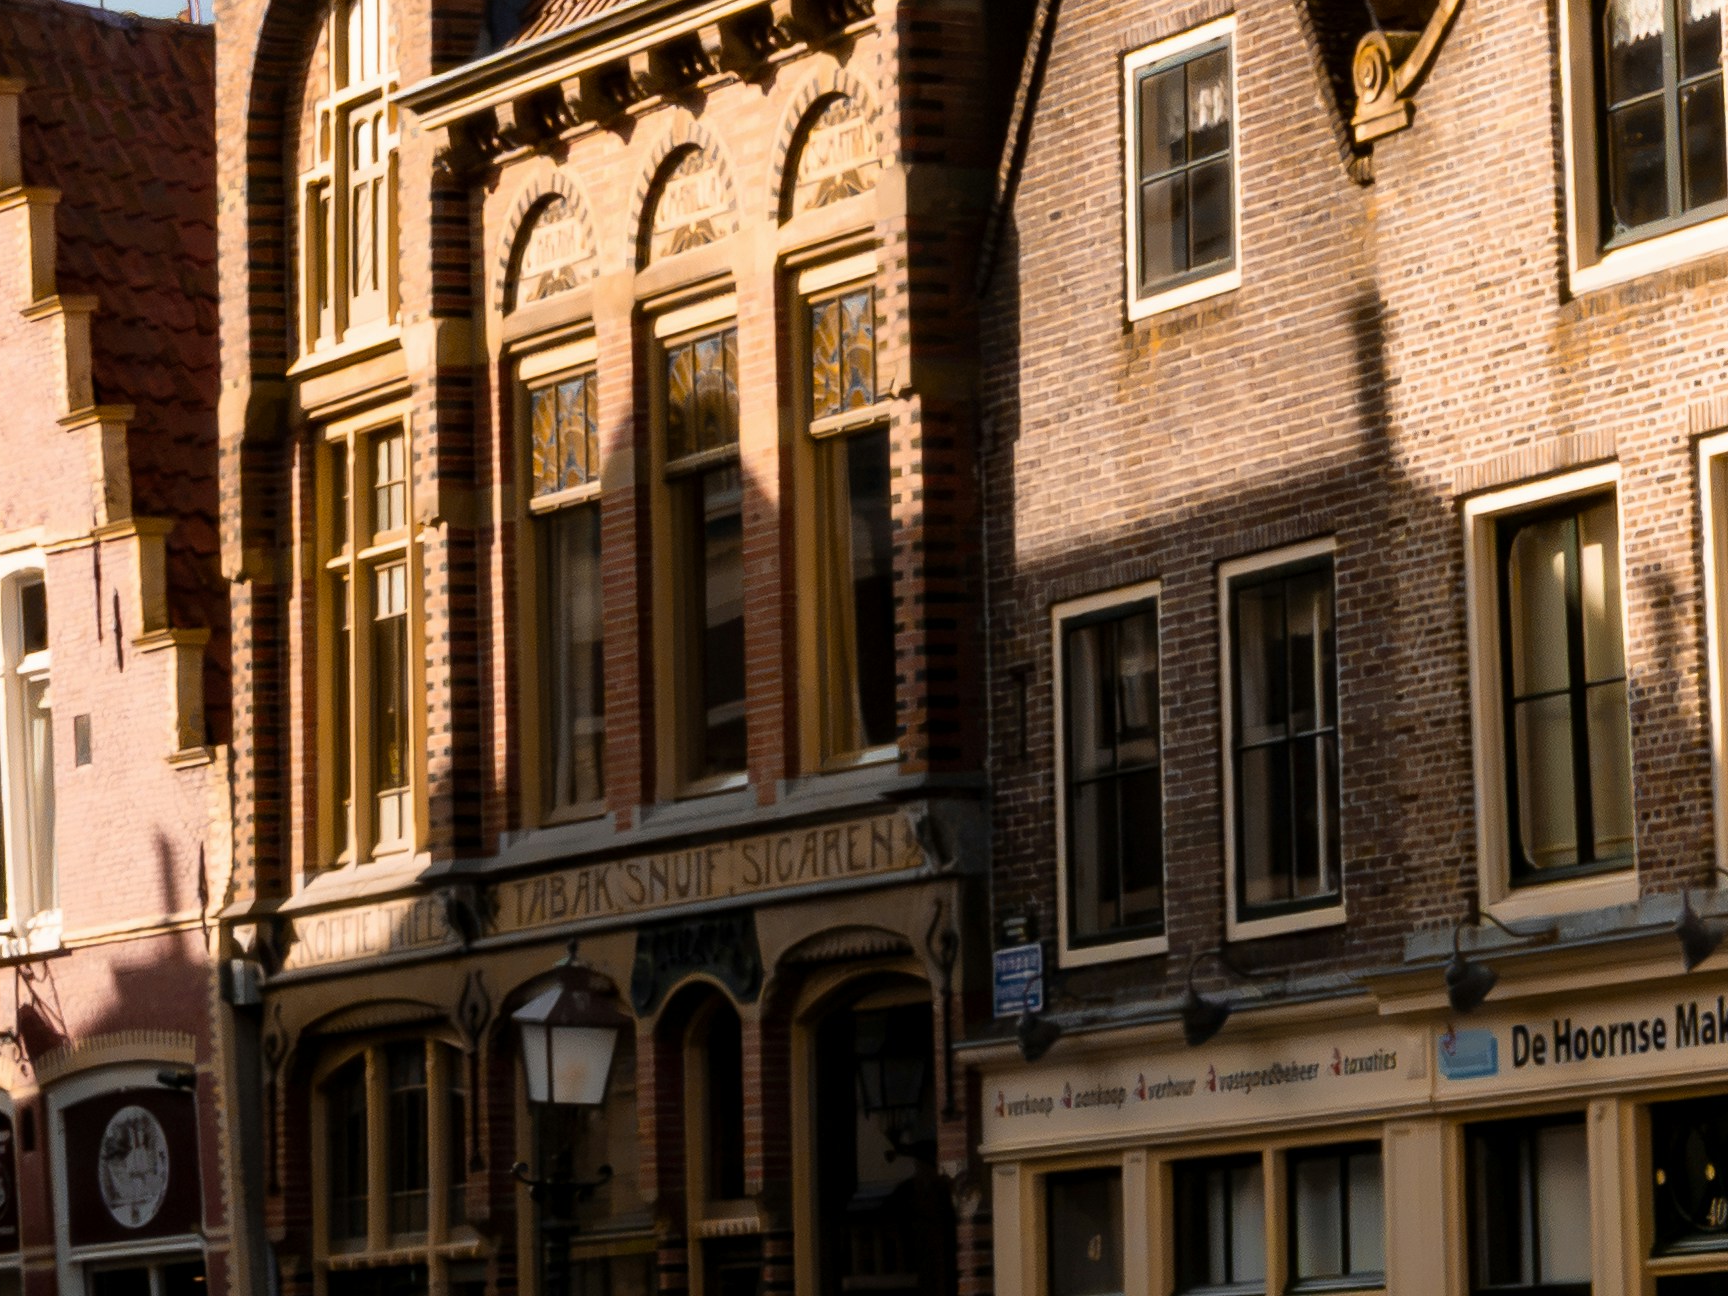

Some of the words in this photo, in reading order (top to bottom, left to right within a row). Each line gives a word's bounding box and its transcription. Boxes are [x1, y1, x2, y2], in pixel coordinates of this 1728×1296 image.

[513, 868, 615, 927] TABAK
[624, 848, 722, 902] SNUIF
[1512, 1024, 1546, 1070] De
[1554, 1014, 1667, 1064] Hoornse
[1007, 1092, 1054, 1120] verkoop
[1075, 1085, 1127, 1113] aankoop
[1148, 1075, 1197, 1101] verhuur
[1218, 1059, 1320, 1096] vastgoedbeheer
[1343, 1047, 1398, 1077] taxaties
